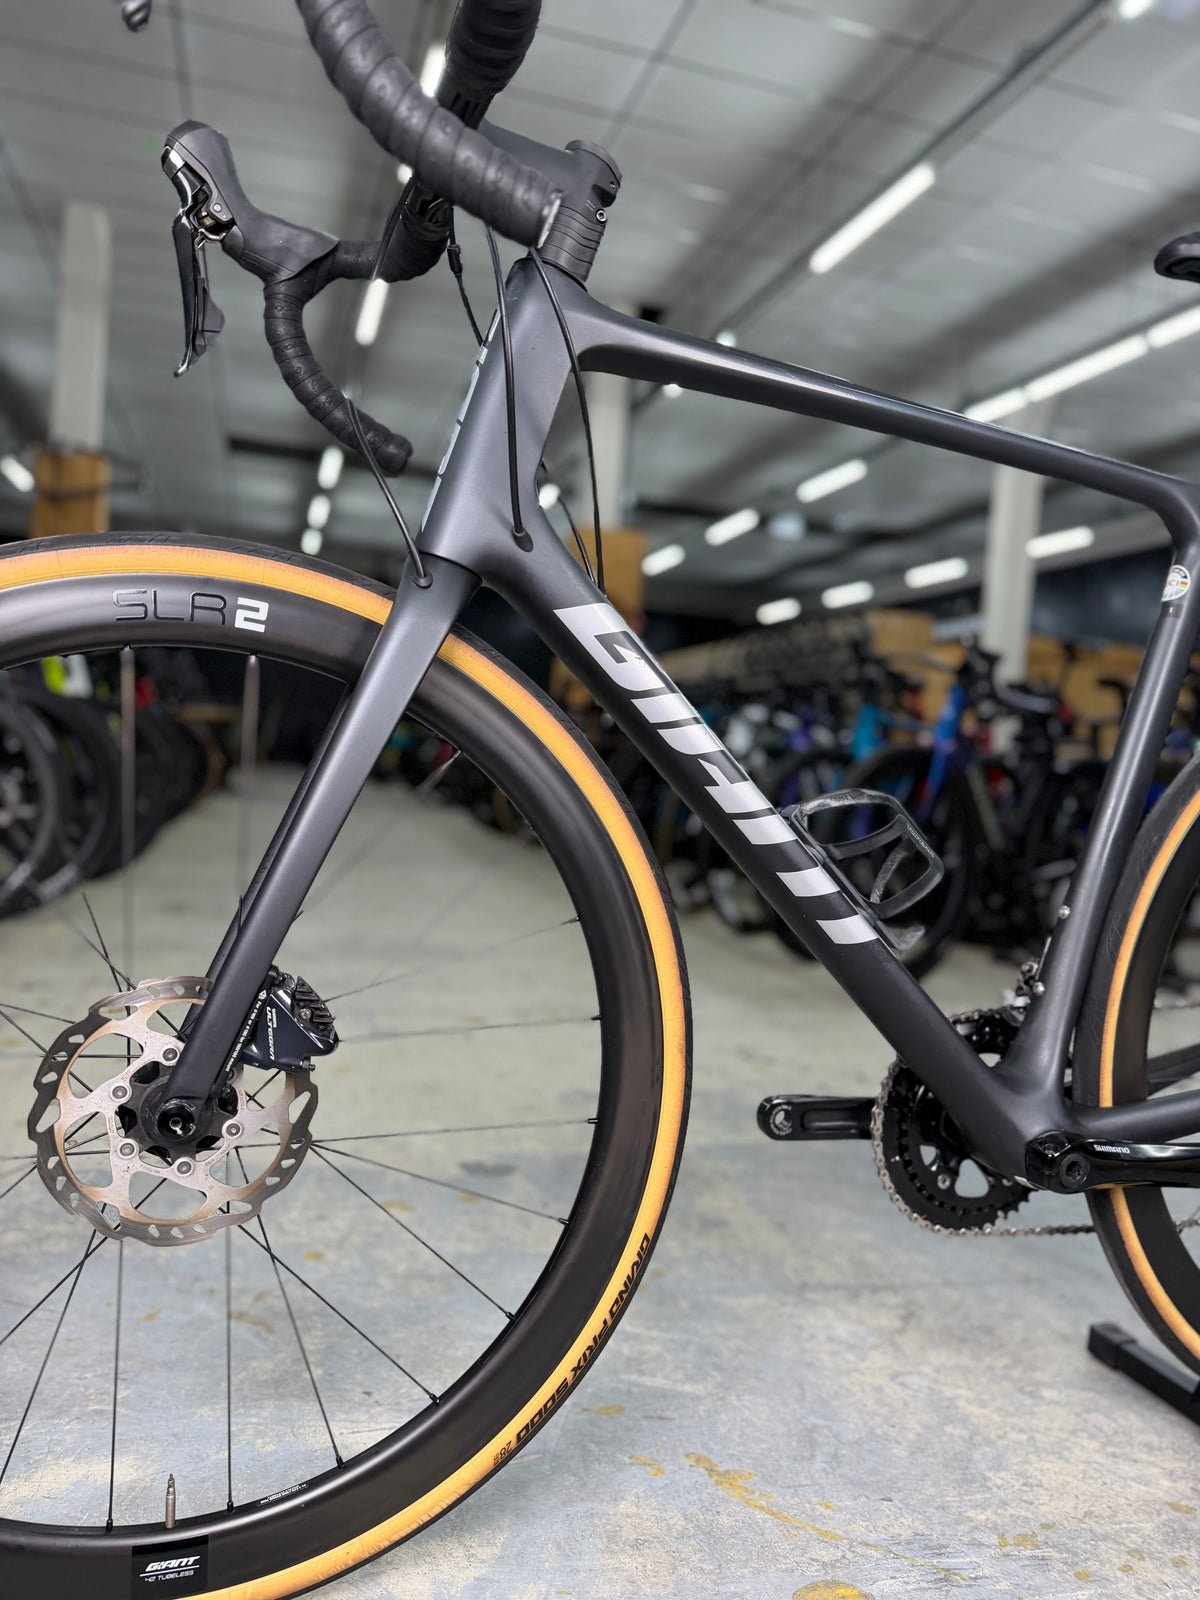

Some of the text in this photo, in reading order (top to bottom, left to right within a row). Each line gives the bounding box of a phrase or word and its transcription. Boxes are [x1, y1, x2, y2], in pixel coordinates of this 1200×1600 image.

[112, 588, 269, 633] SLR 2
[266, 1006, 275, 1060] ULTEGRA
[1093, 1144, 1131, 1154] SHIMANO
[609, 1233, 650, 1320] GRAND
[570, 1318, 611, 1381] PRIX
[516, 1376, 569, 1446] 5000
[144, 1555, 201, 1572] GIANT
[158, 1569, 195, 1581] TUBELESS
